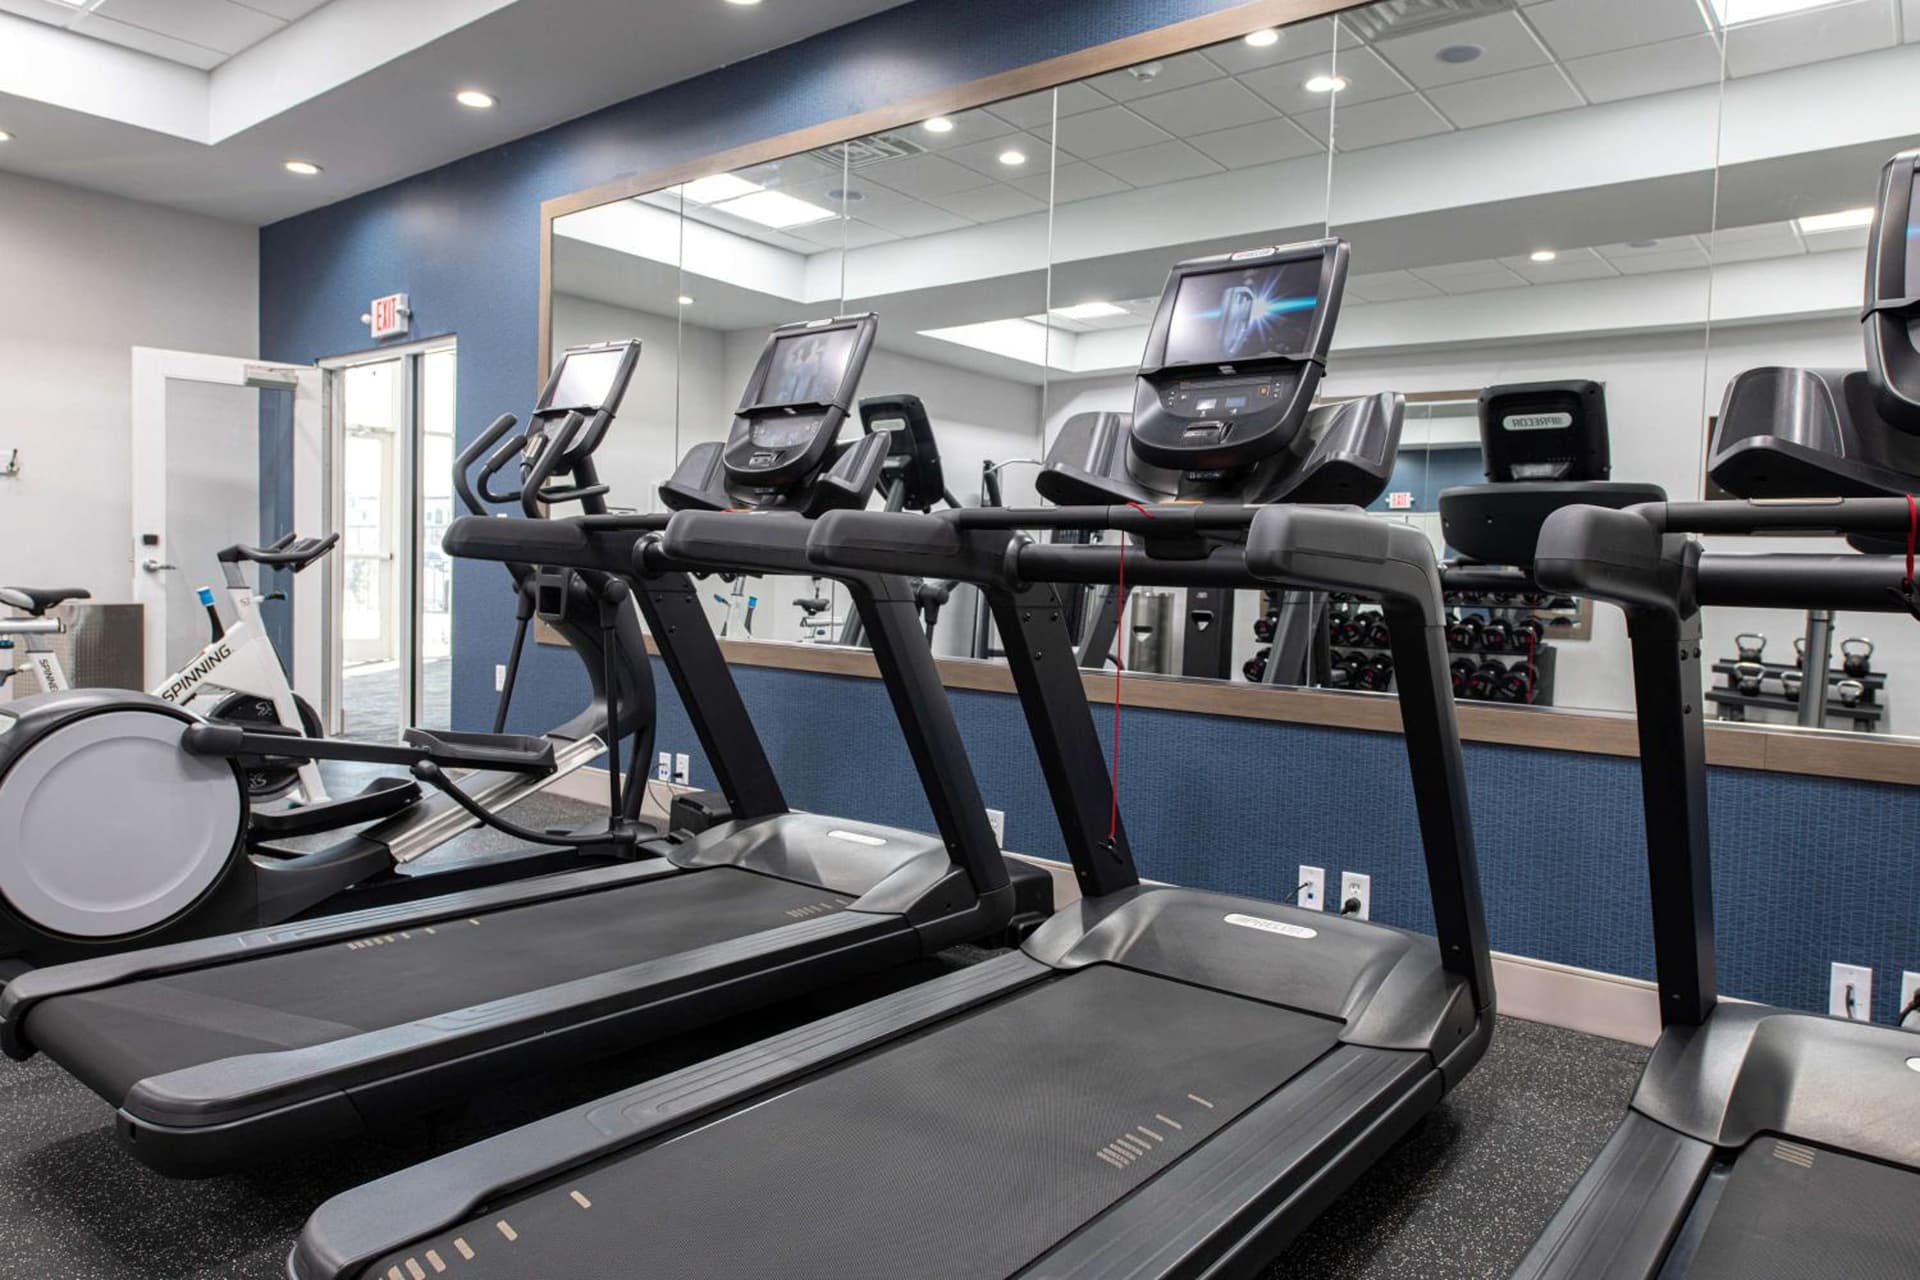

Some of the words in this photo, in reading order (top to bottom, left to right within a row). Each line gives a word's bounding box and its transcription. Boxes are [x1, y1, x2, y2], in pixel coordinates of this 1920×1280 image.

[377, 298, 396, 330] EXIT
[38, 659, 59, 690] SPINNE
[162, 644, 232, 702] SPINNING
